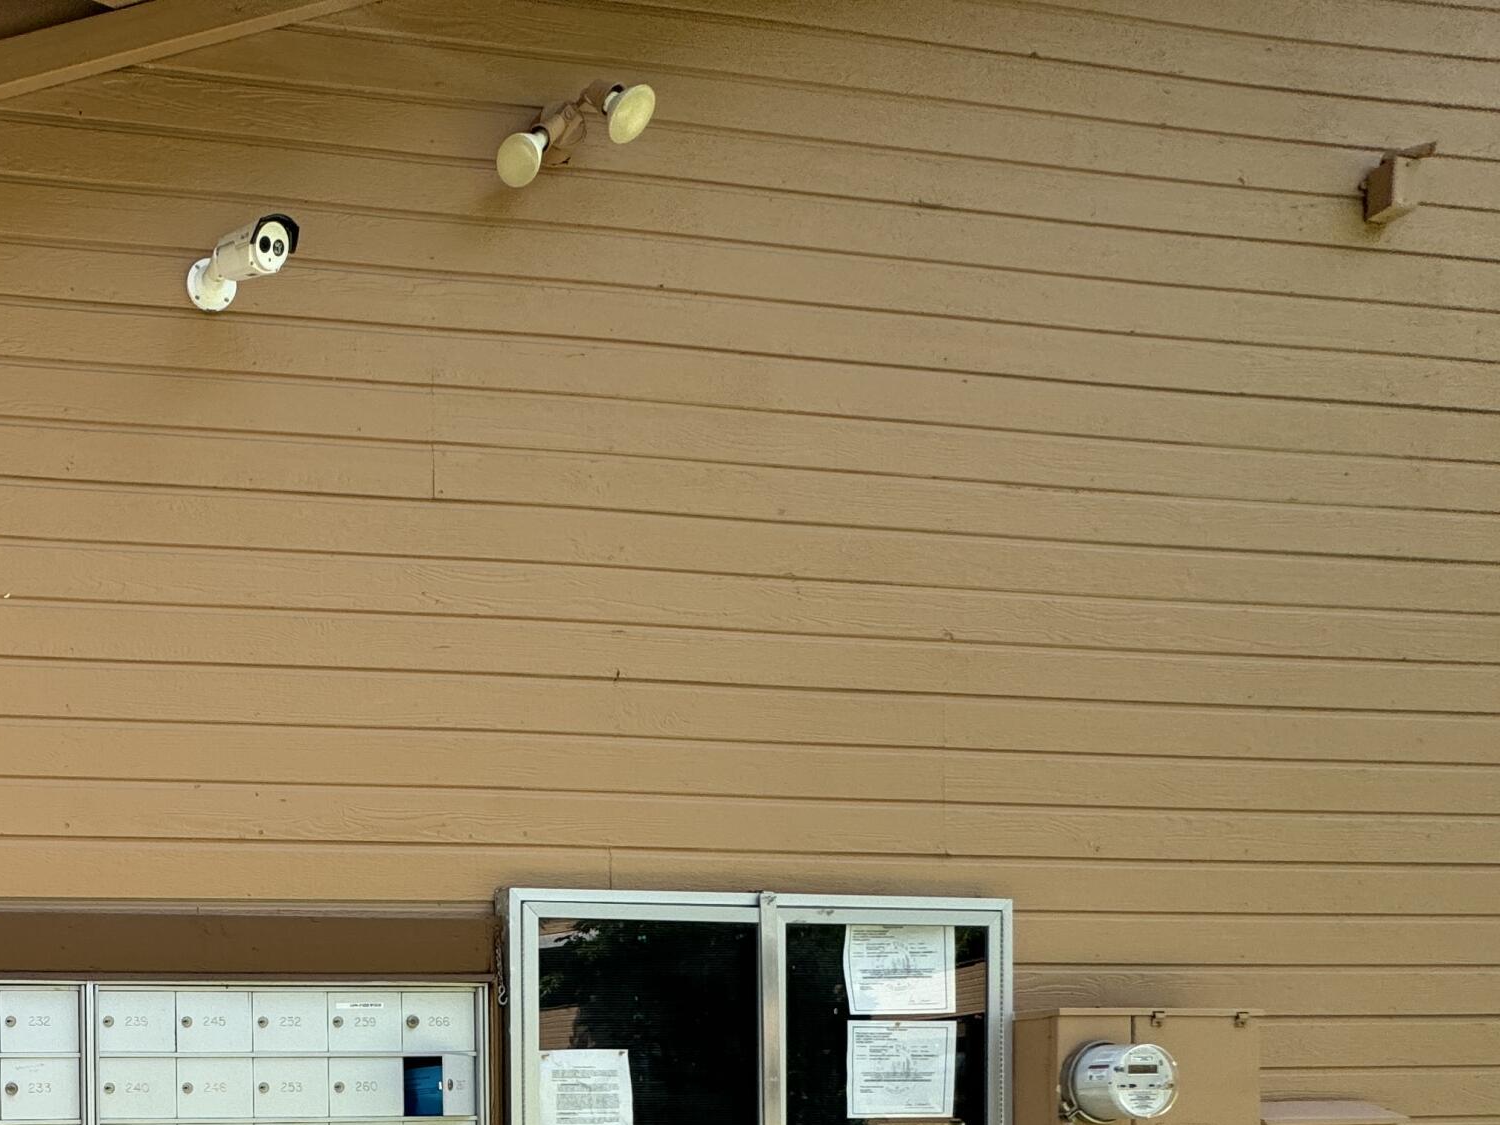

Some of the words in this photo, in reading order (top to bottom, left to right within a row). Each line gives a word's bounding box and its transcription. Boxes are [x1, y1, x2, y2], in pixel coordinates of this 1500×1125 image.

[28, 1015, 51, 1027] 232
[202, 1016, 226, 1027] 245
[279, 1016, 302, 1027] 252
[354, 1017, 377, 1028] 259
[428, 1016, 451, 1027] 266
[125, 1082, 150, 1094] 240
[280, 1081, 303, 1093] 253
[355, 1080, 378, 1092] 260
